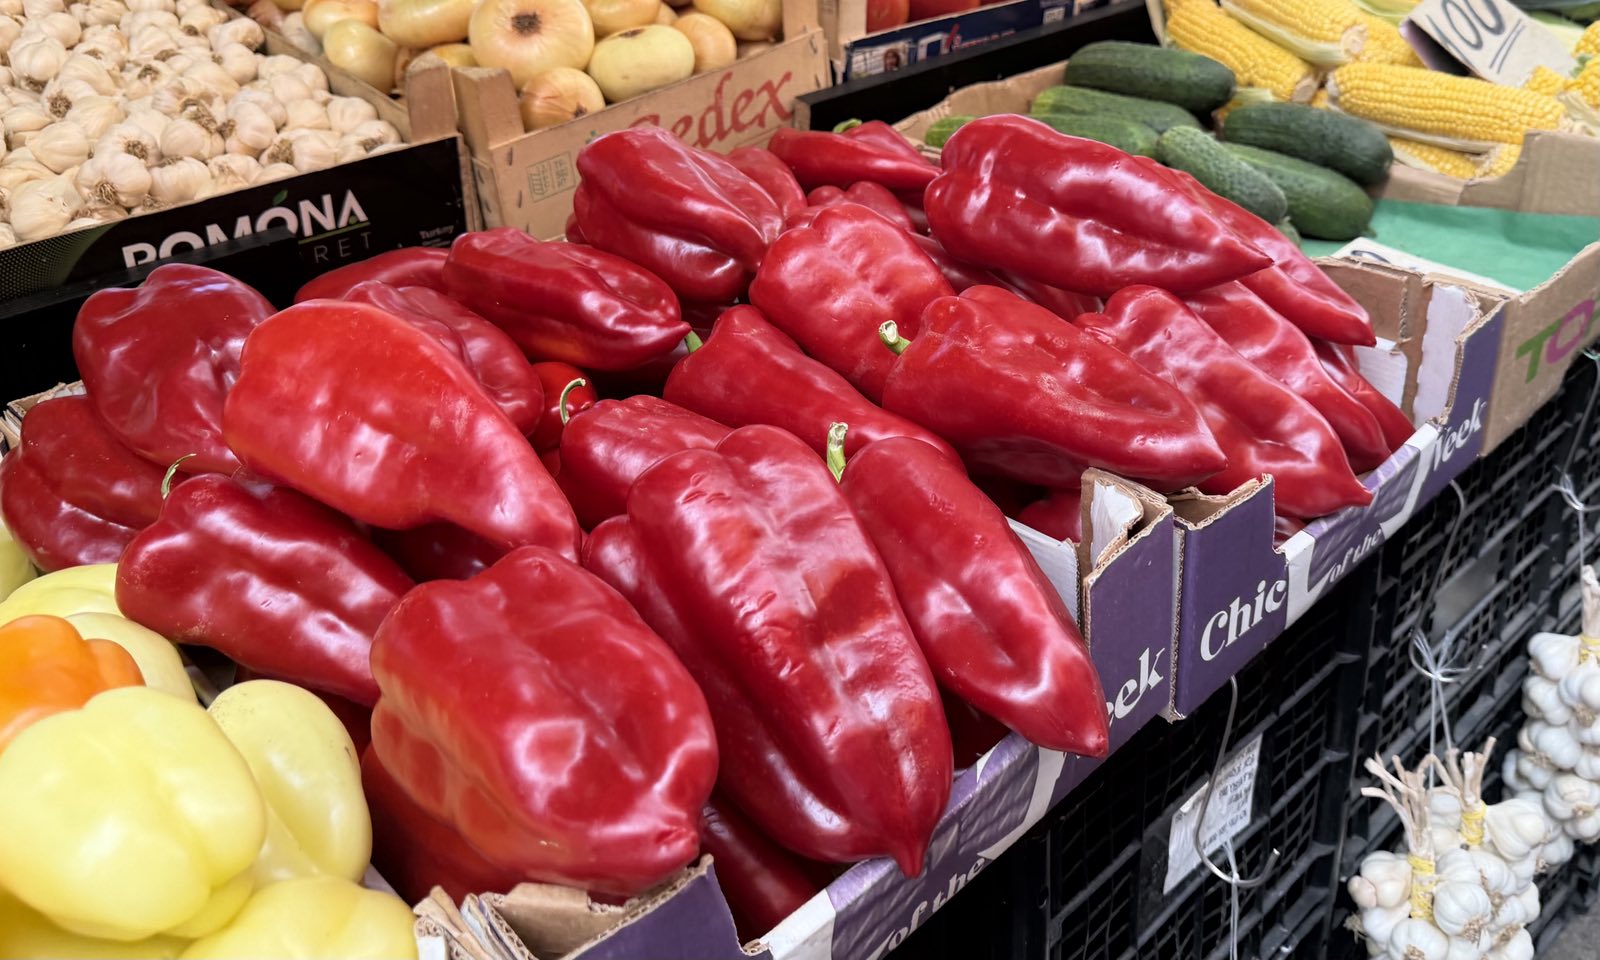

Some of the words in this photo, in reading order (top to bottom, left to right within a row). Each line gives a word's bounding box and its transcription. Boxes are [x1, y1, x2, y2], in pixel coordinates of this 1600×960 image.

[1515, 298, 1600, 385] TO
[1200, 579, 1287, 662] Chic
[1329, 547, 1355, 583] of
[1352, 528, 1382, 563] the
[888, 900, 928, 951] of
[932, 857, 986, 913] the
